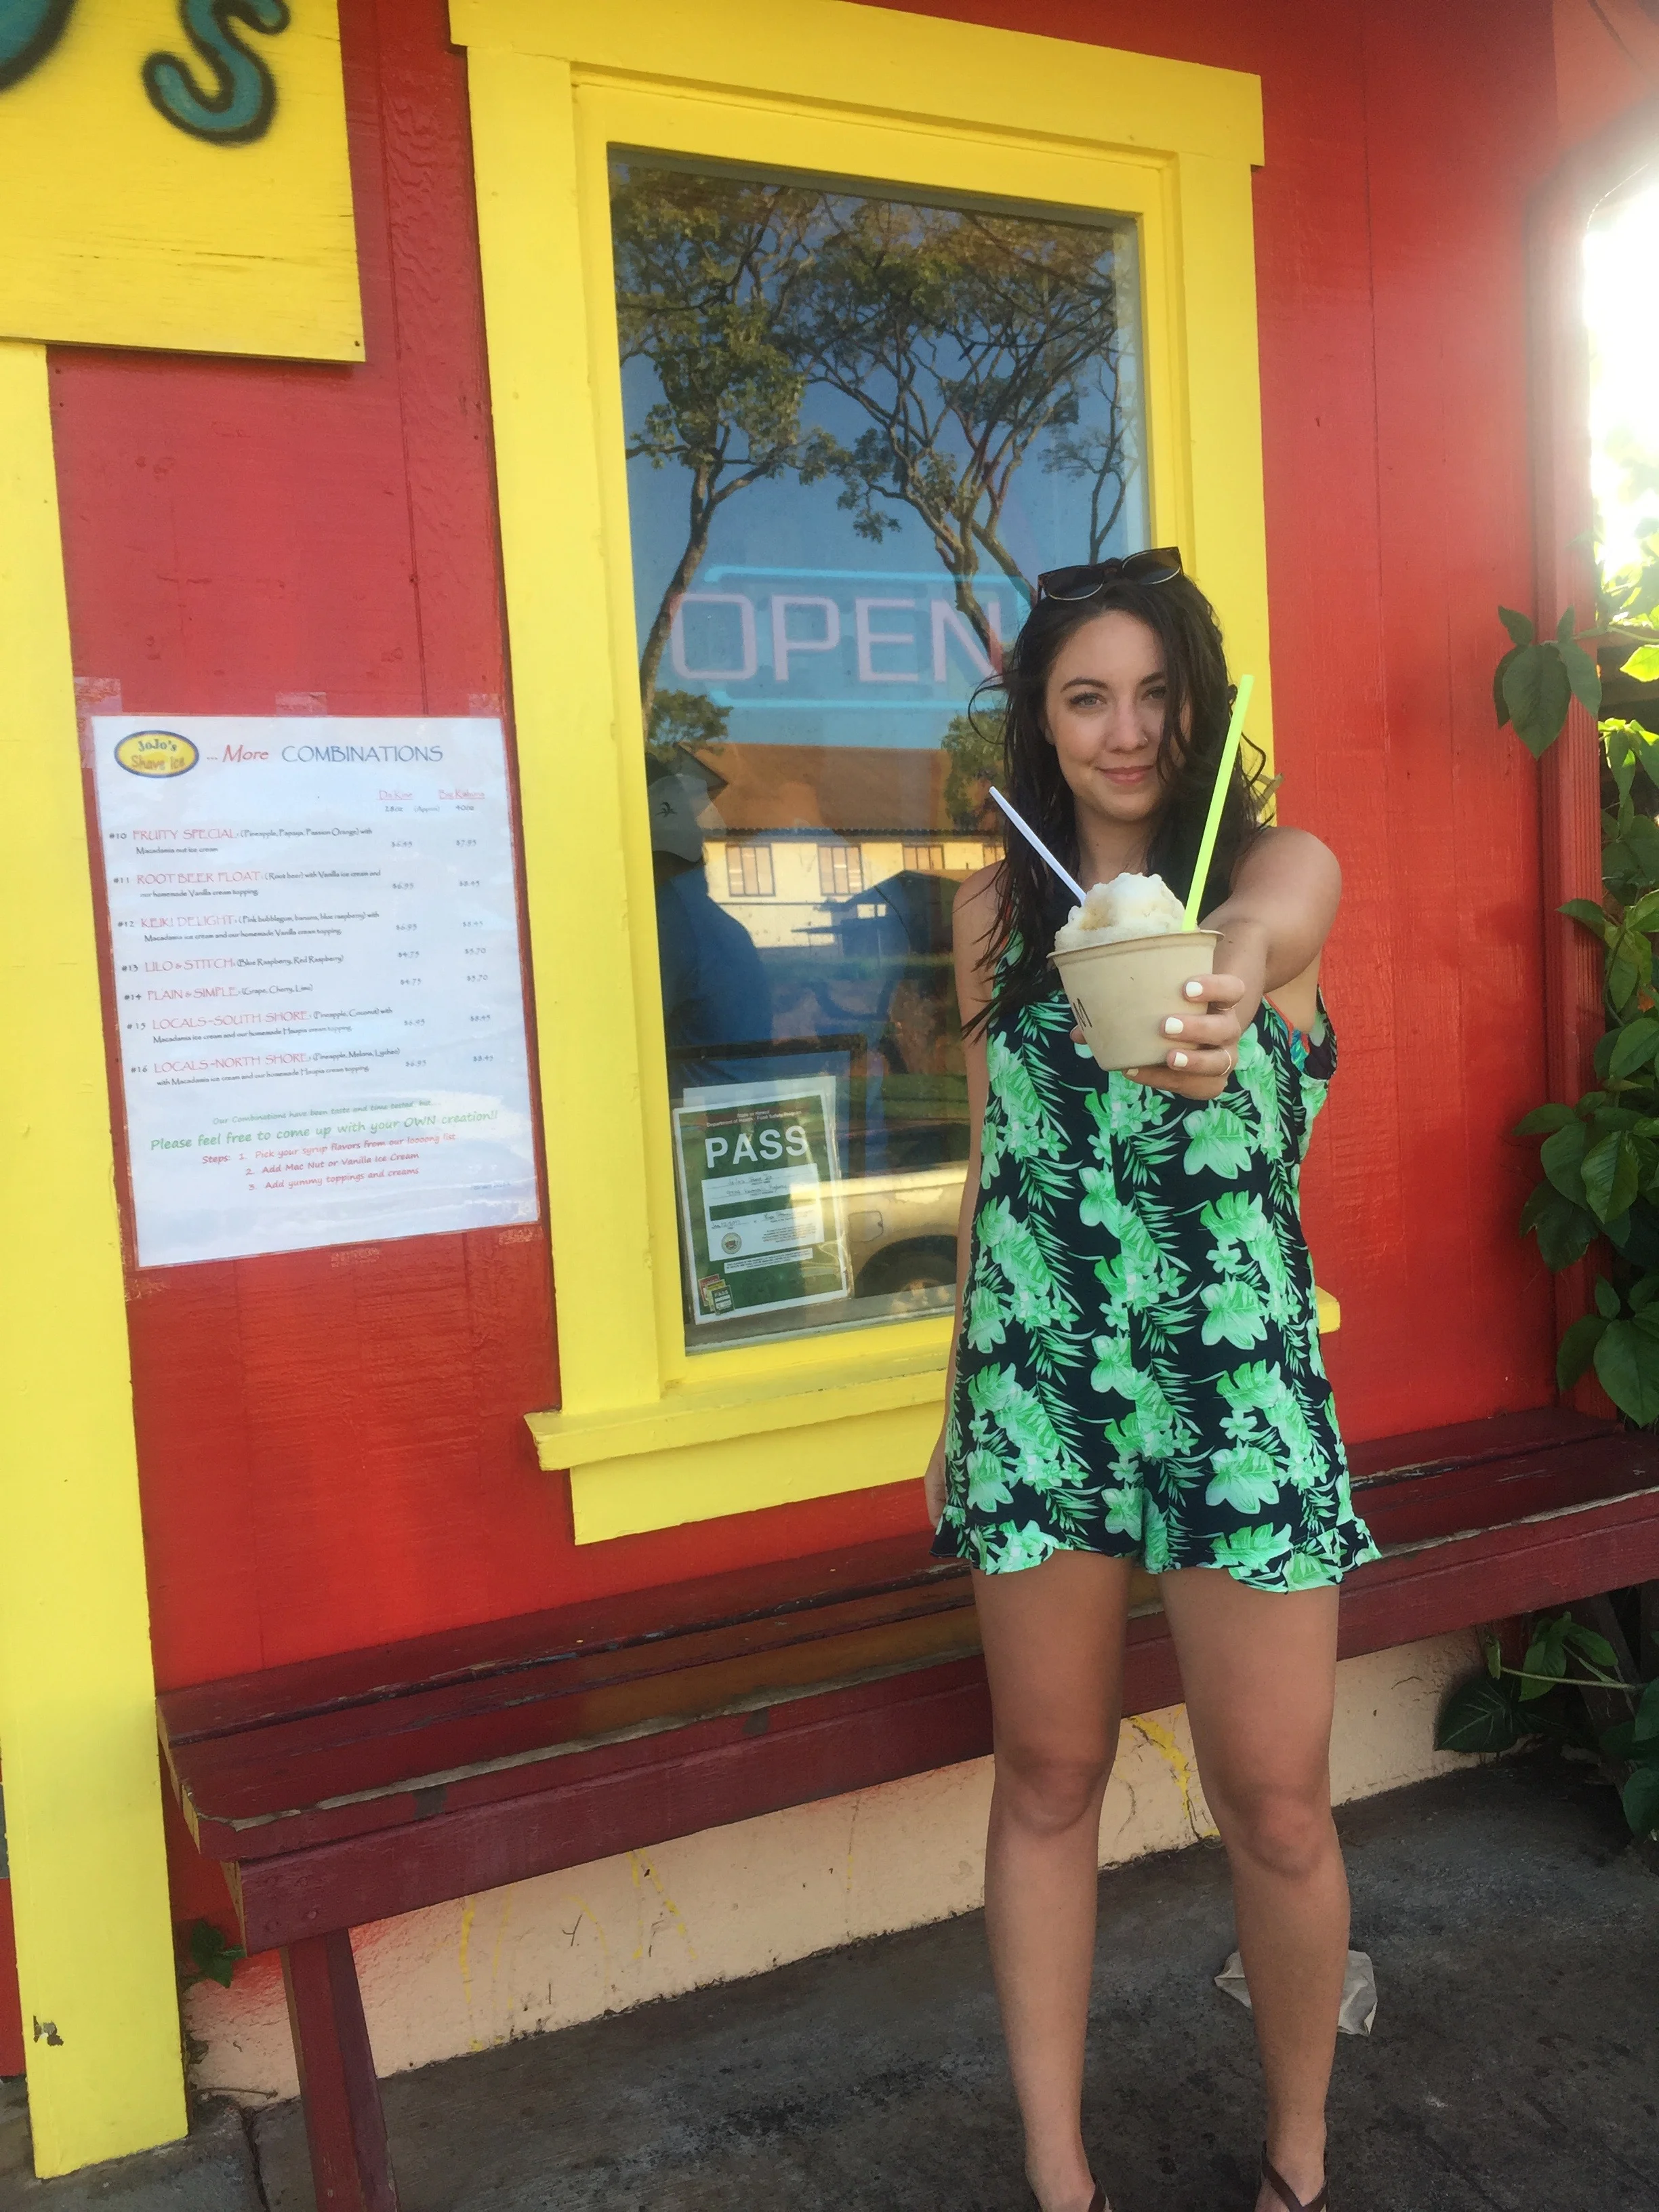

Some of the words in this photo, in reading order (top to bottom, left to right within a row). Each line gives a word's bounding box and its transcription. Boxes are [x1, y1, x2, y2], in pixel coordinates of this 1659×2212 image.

[670, 592, 1003, 683] OPEN
[222, 744, 269, 762] More
[282, 745, 443, 762] COMBINATIONS
[133, 830, 179, 840] FRUITY
[137, 874, 176, 884] ROOT
[178, 872, 214, 884] BEER
[318, 869, 340, 878] Vanilla
[188, 888, 211, 897] Vanilla
[141, 917, 173, 928] KEIKI
[144, 935, 183, 943] Macadamia
[144, 960, 173, 972] LILO
[293, 956, 307, 964] Red
[308, 955, 344, 965] Raspberry)
[148, 989, 183, 1001] PLAIN
[153, 1036, 191, 1044] Macadamia
[249, 1029, 282, 1037] homemade
[131, 1065, 148, 1073] #16
[171, 1076, 209, 1086] Macadamia
[266, 1069, 300, 1078] homemade
[213, 1117, 229, 1125] Our
[231, 1111, 286, 1124] Combinations
[150, 1138, 192, 1151] Please
[197, 1133, 221, 1147] feel
[226, 1131, 251, 1144] free
[257, 1130, 271, 1141] to
[276, 1128, 310, 1139] come
[315, 1126, 331, 1139] up
[337, 1122, 366, 1134] with
[370, 1120, 400, 1134] your
[403, 1115, 436, 1128] OWN
[441, 1109, 498, 1124] creation!!
[202, 1154, 231, 1165] Steps:
[255, 1149, 274, 1160] Pick
[278, 1149, 298, 1159] your
[302, 1145, 328, 1155] syrup
[331, 1142, 361, 1151] flavors
[363, 1139, 386, 1149] from
[443, 1132, 455, 1141] list
[705, 1125, 808, 1168] PASS
[262, 1165, 282, 1174] Add
[285, 1163, 304, 1172] Mac
[308, 1162, 325, 1170] Nut
[341, 1156, 372, 1166] Vanilla
[375, 1155, 387, 1163] Ice
[390, 1152, 419, 1161] Cream
[265, 1180, 285, 1189] Add
[288, 1178, 323, 1189] yummy
[326, 1173, 365, 1184] toppings
[367, 1170, 385, 1179] and
[388, 1167, 419, 1176] creams
